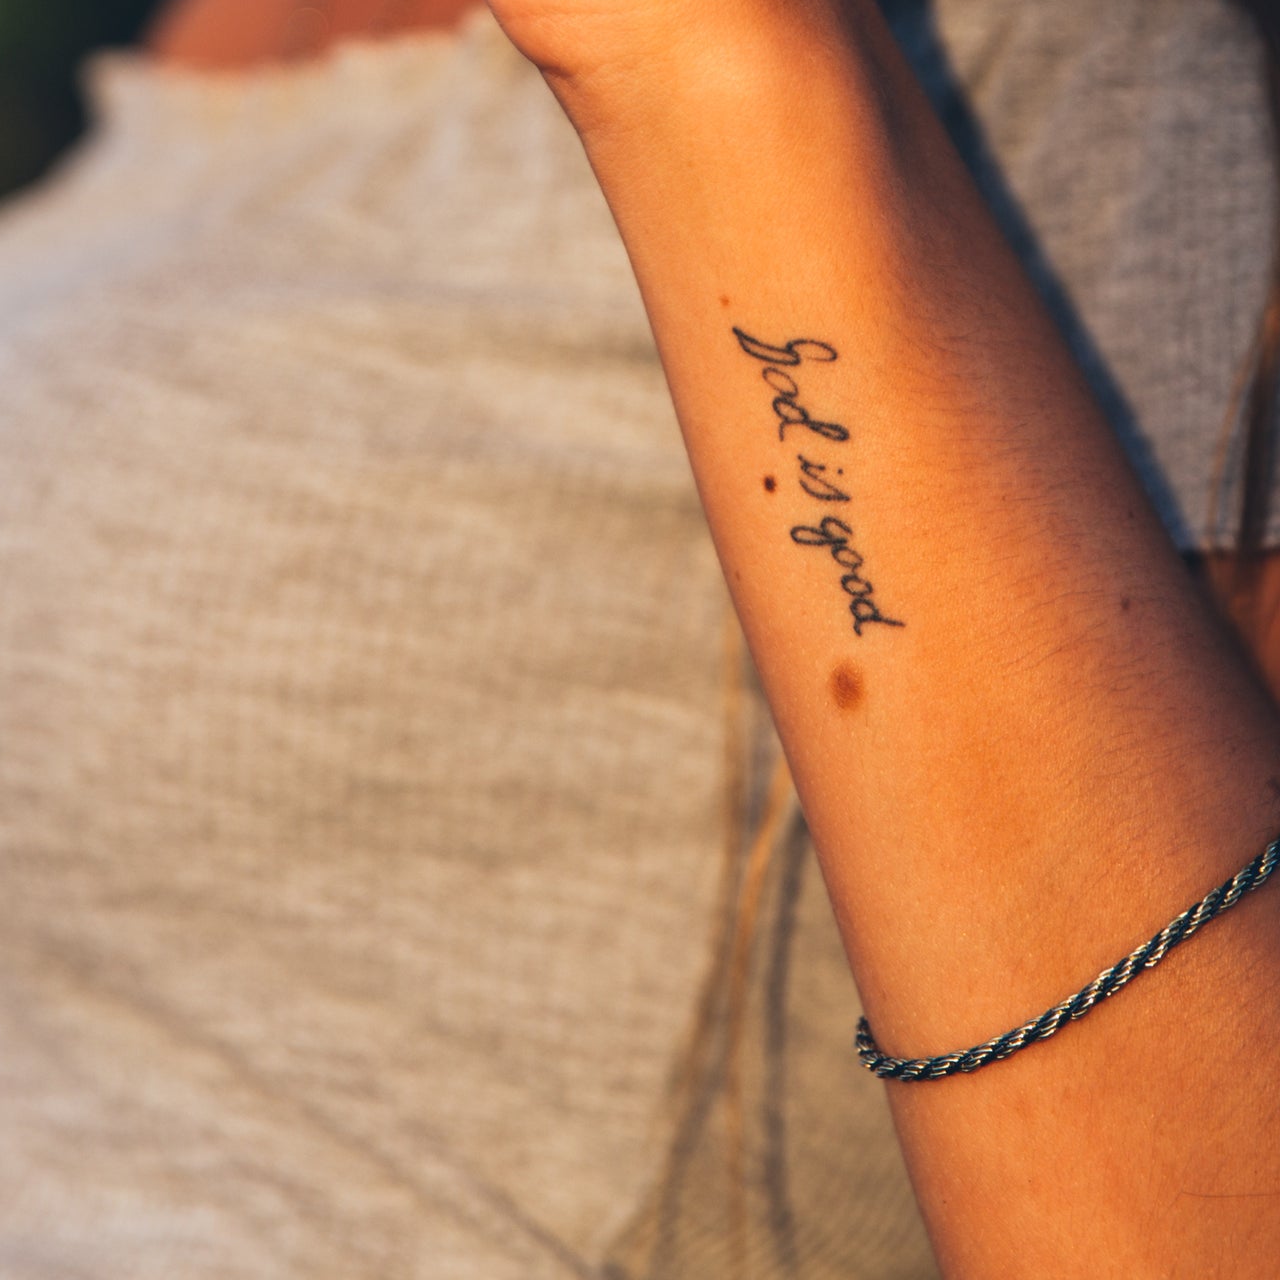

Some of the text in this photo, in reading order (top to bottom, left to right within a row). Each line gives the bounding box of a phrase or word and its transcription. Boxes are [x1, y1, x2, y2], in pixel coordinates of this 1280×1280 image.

[732, 326, 906, 637] God is good
